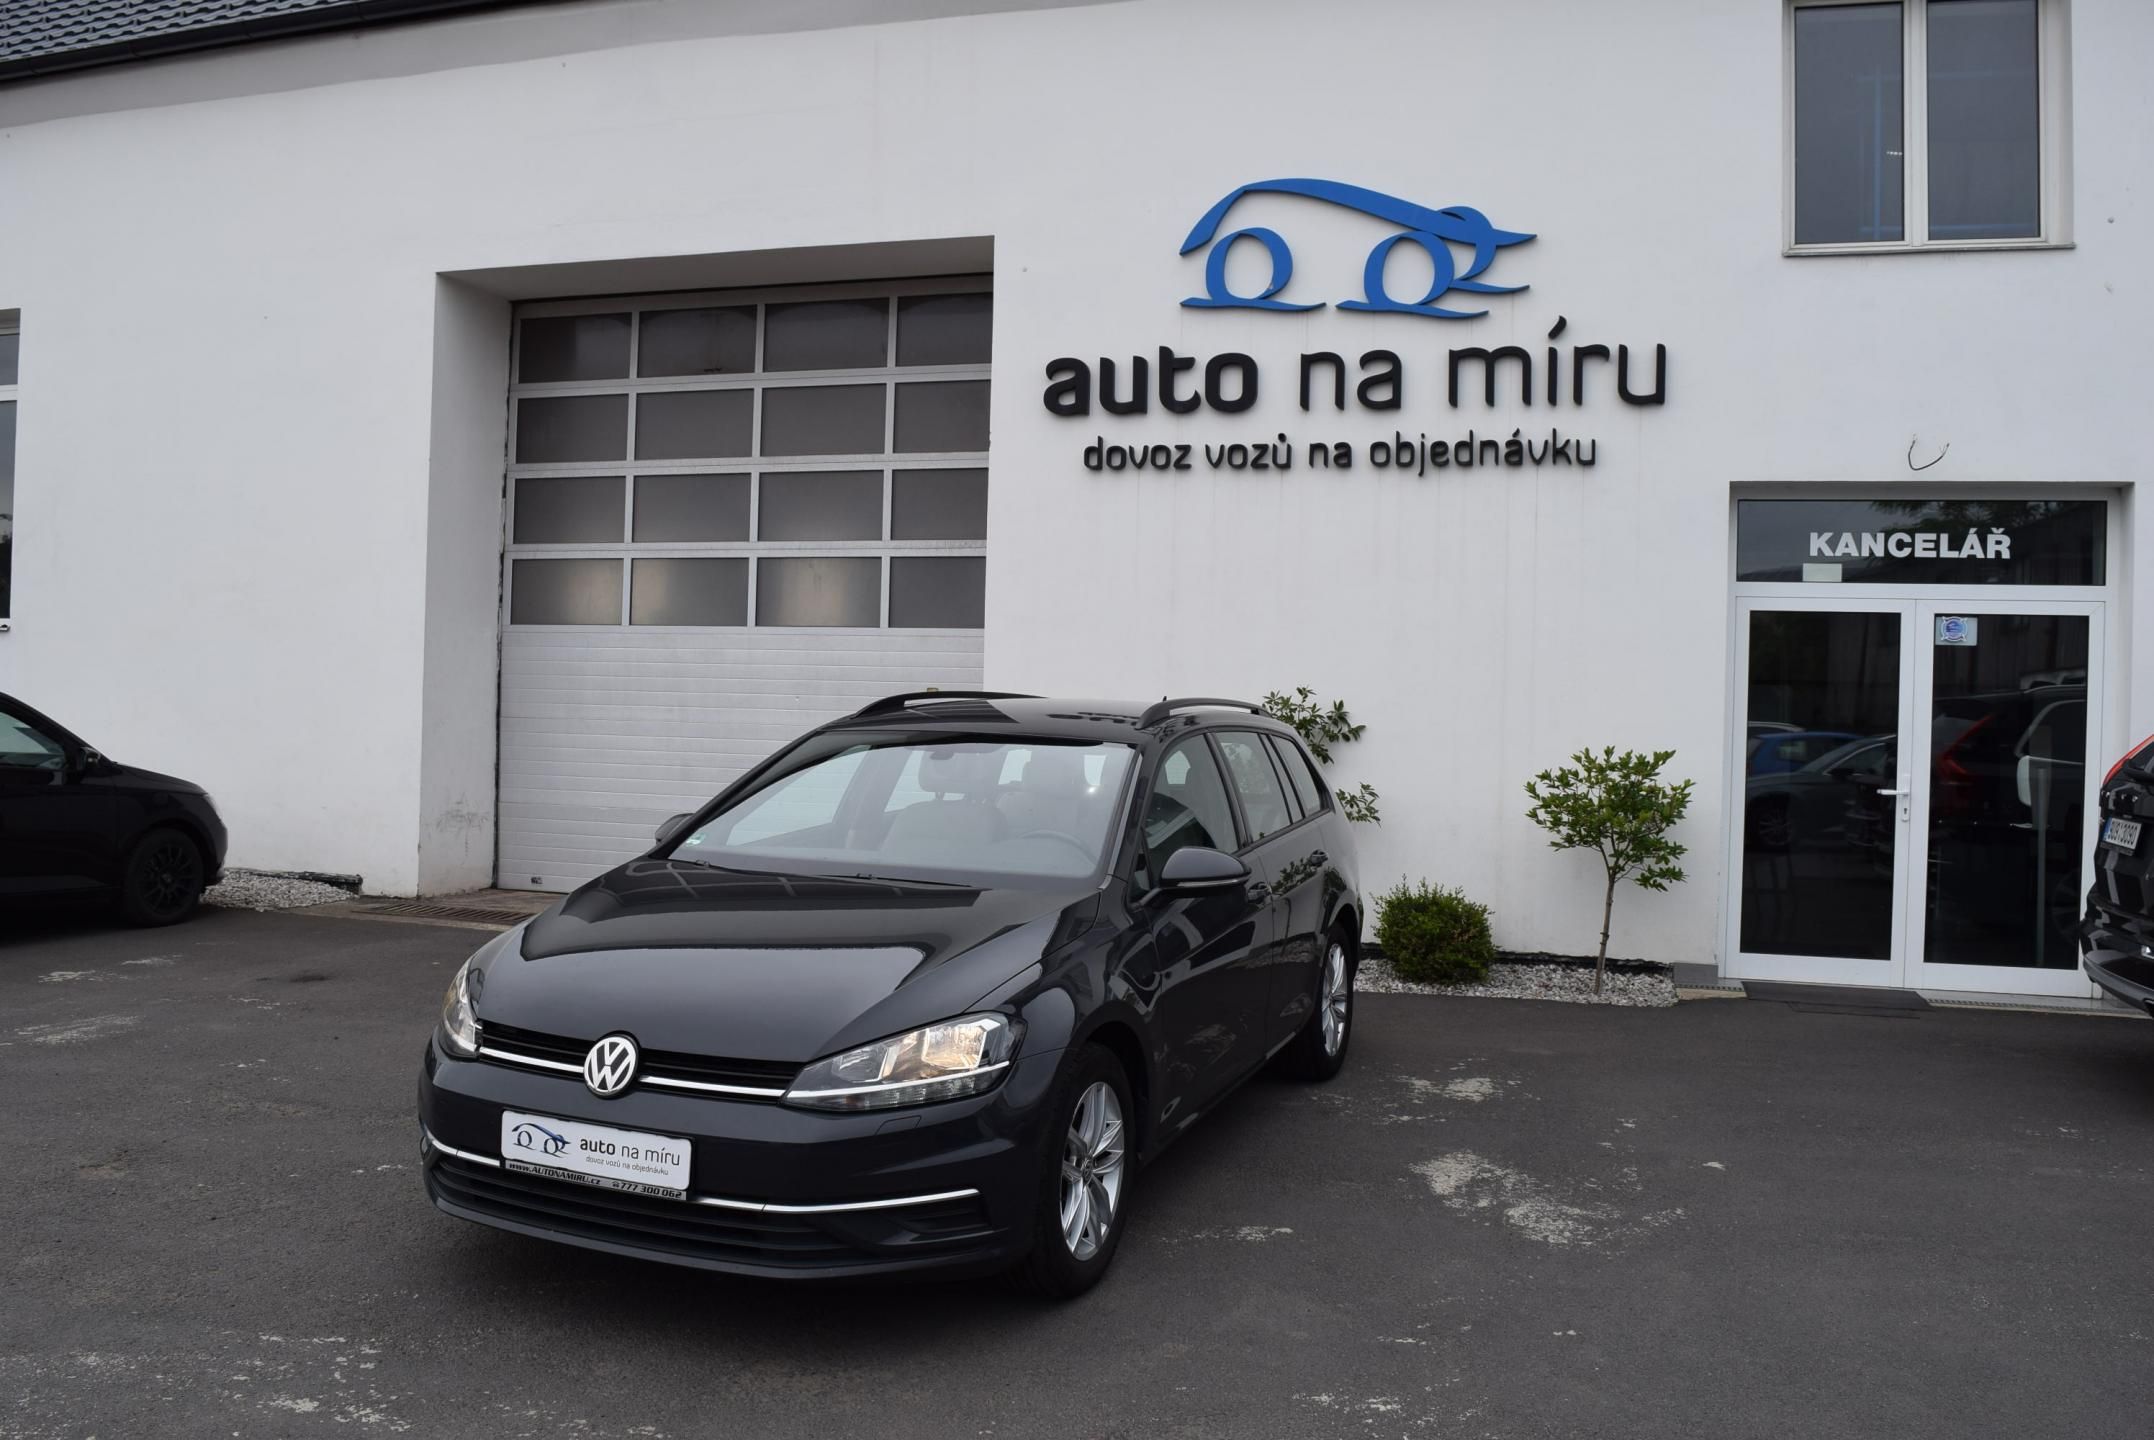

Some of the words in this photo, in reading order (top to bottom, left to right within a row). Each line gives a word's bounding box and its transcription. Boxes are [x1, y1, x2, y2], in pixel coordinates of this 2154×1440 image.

[1044, 346, 1258, 416] auto
[1300, 349, 1402, 412] na
[1449, 315, 1666, 408] míru
[1083, 436, 1192, 471] dovoz
[1205, 433, 1292, 470] vozů
[1309, 441, 1352, 470] na
[1369, 428, 1596, 477] objednávku
[1809, 527, 2011, 559] KANCELÁŘ
[579, 1138, 616, 1156] auto
[621, 1145, 639, 1160] na
[645, 1147, 681, 1166] míru
[585, 1155, 605, 1165] dovoz
[605, 1159, 621, 1168] vozů
[622, 1162, 631, 1170] na
[631, 1164, 669, 1176] objednávku
[621, 1182, 639, 1192] 777
[640, 1185, 660, 1196] 300
[661, 1189, 683, 1199] 062
